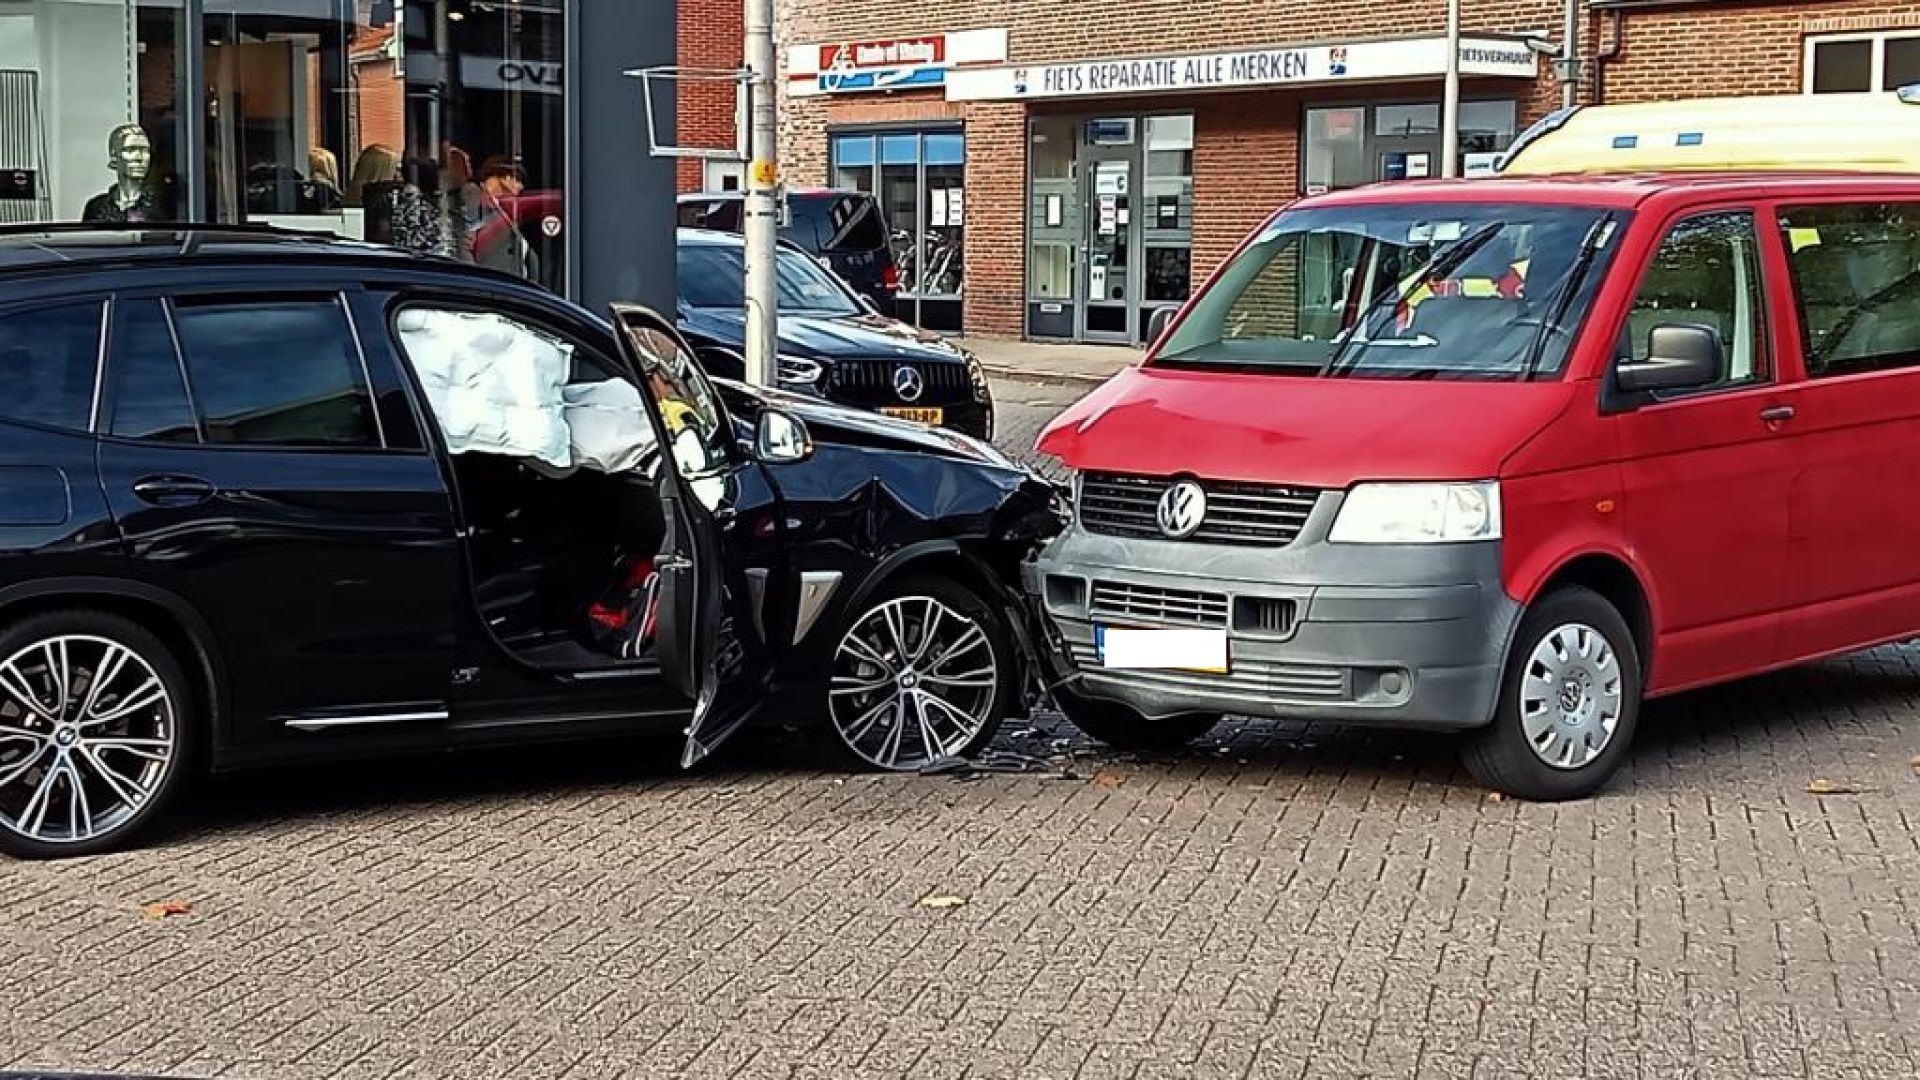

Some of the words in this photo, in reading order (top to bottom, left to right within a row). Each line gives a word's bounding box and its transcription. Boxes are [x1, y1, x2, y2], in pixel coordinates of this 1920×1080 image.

[1044, 67, 1082, 91] FIETS
[1089, 59, 1176, 89] REPARATIE
[1184, 57, 1224, 83] ALLE
[1230, 51, 1307, 80] MERKEN
